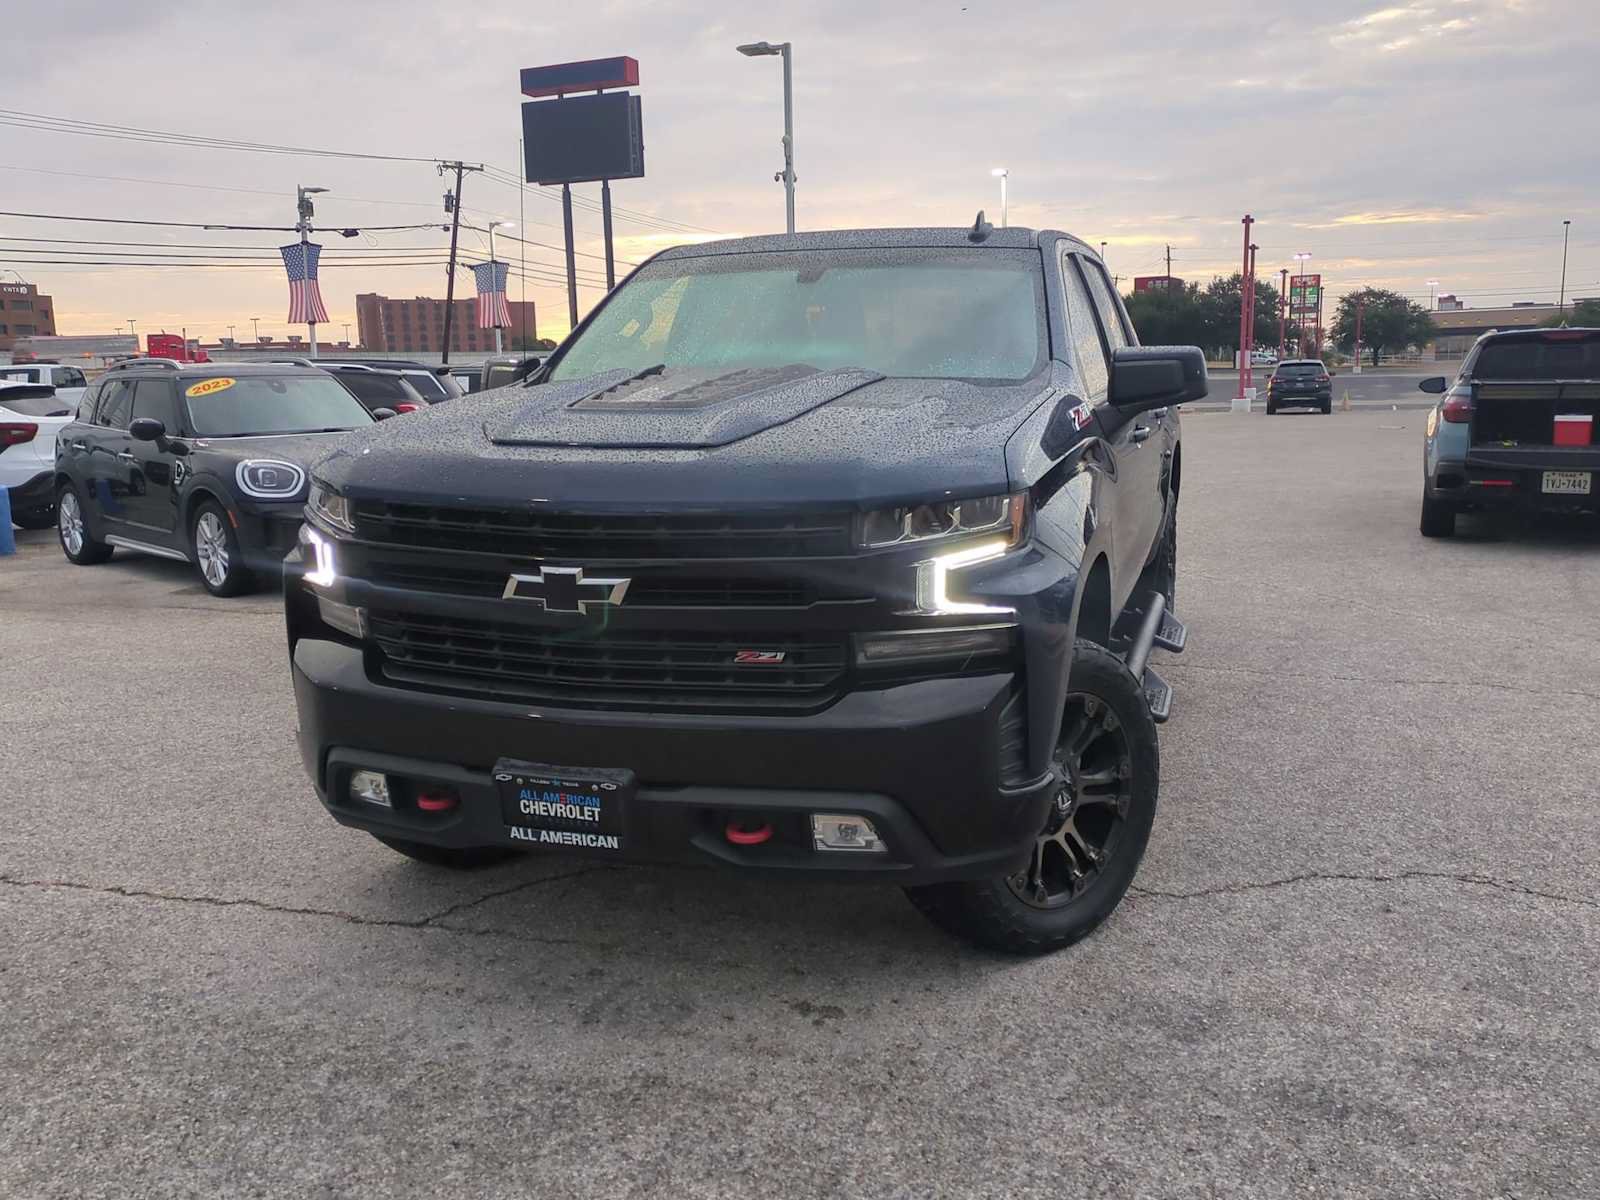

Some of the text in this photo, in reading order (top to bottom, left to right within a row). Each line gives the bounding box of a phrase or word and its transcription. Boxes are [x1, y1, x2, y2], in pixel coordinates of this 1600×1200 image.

[192, 379, 231, 394] 2023
[520, 789, 600, 807] ALL AMERICAN
[519, 799, 601, 822] CHEVROLET
[510, 826, 619, 849] ALL AMERICAN
